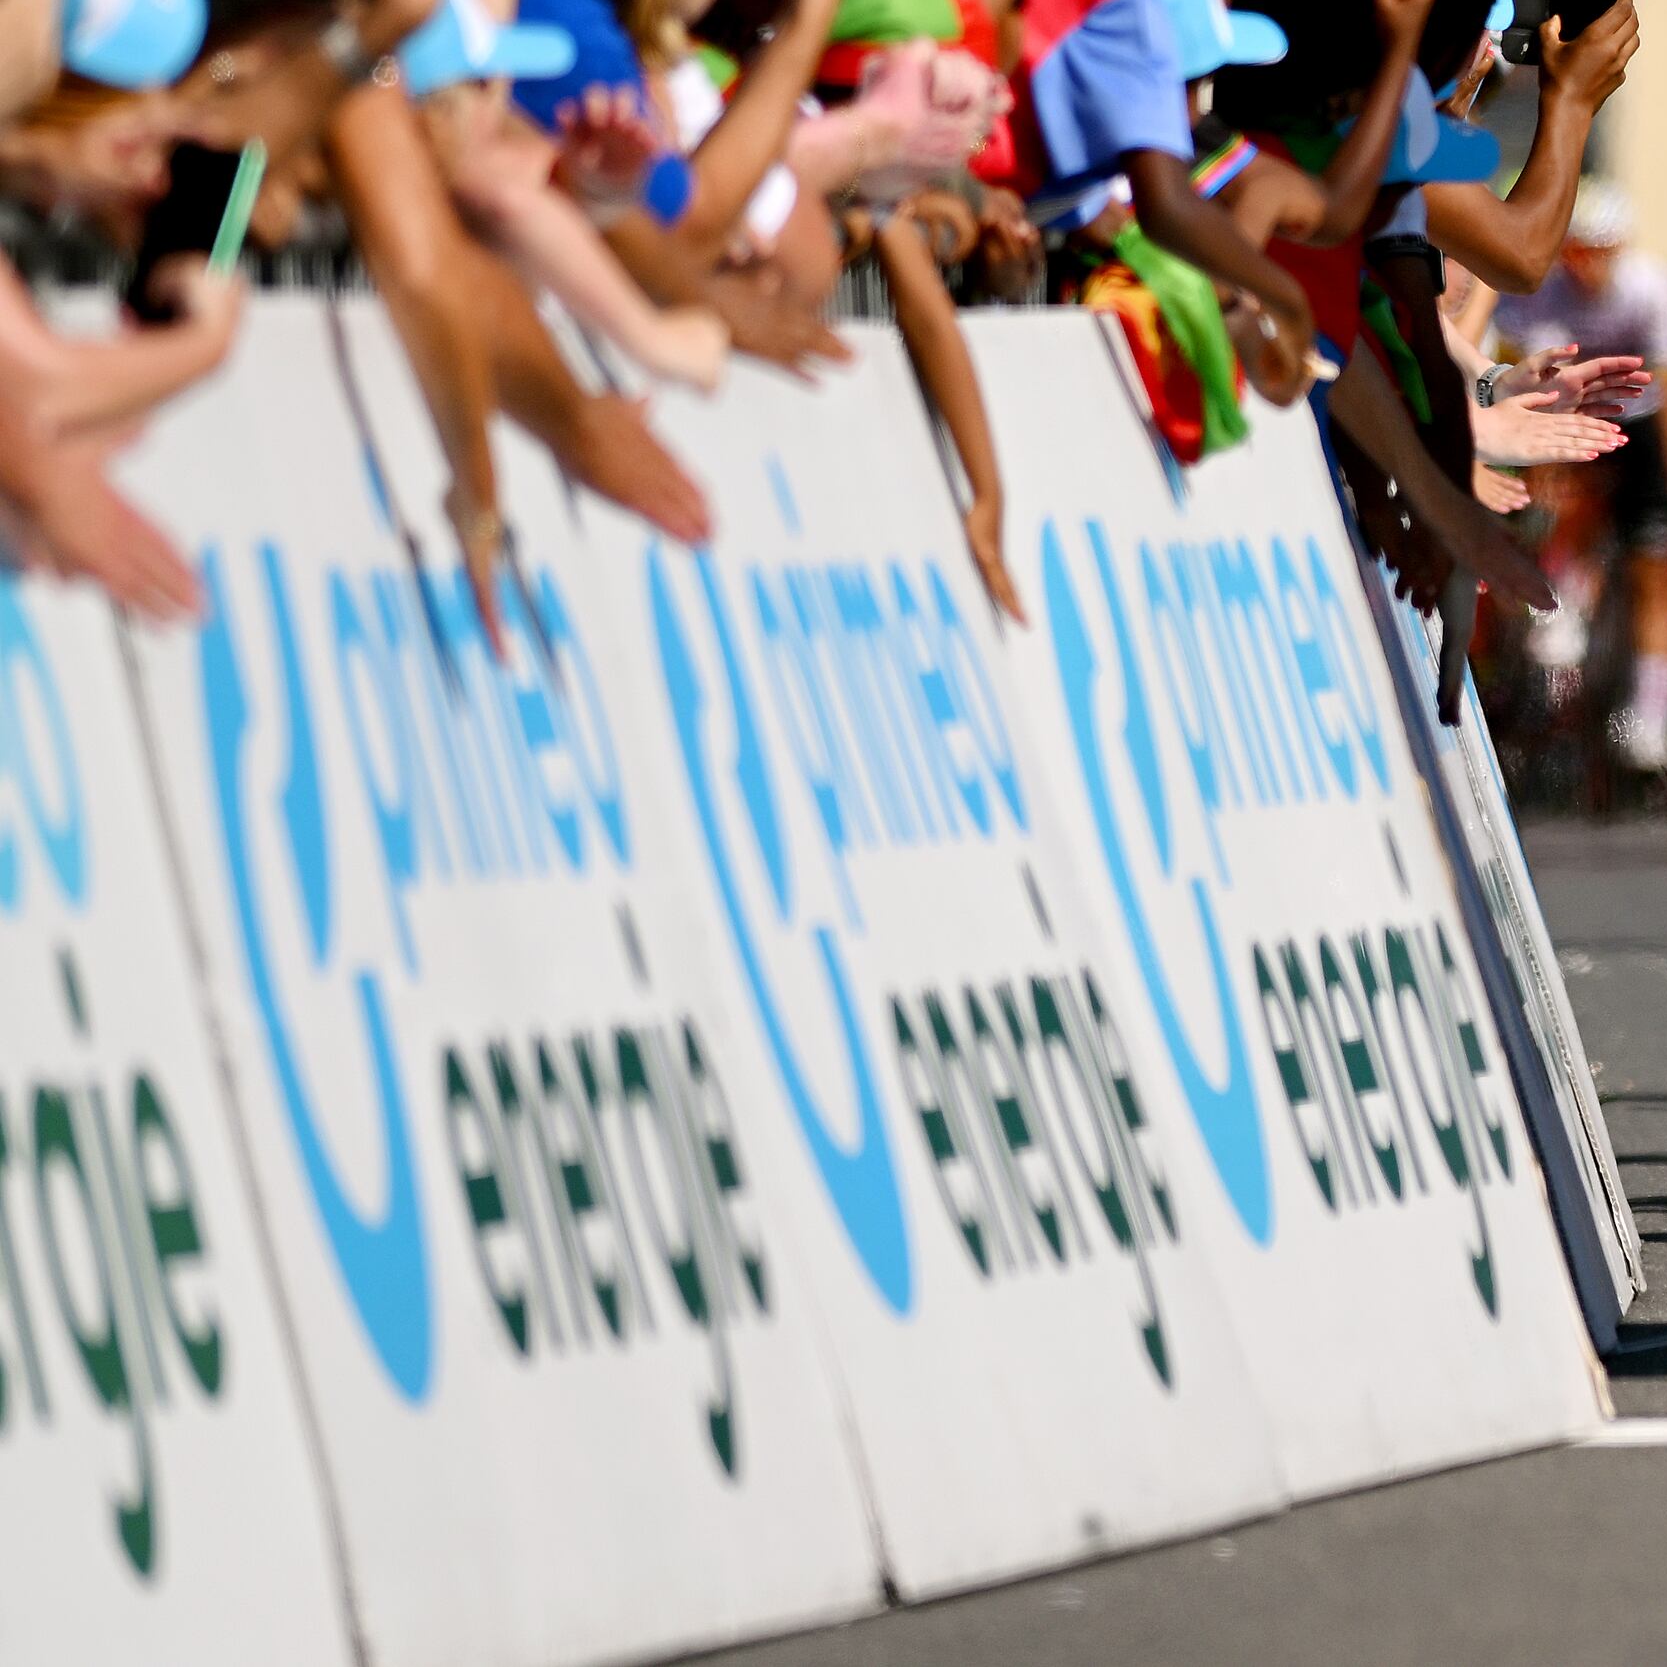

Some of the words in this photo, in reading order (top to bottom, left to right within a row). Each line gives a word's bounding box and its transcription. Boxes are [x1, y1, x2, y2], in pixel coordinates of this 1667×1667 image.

[443, 899, 772, 1484] energie
[890, 864, 1181, 1394] energie
[1252, 820, 1512, 1322] energie
